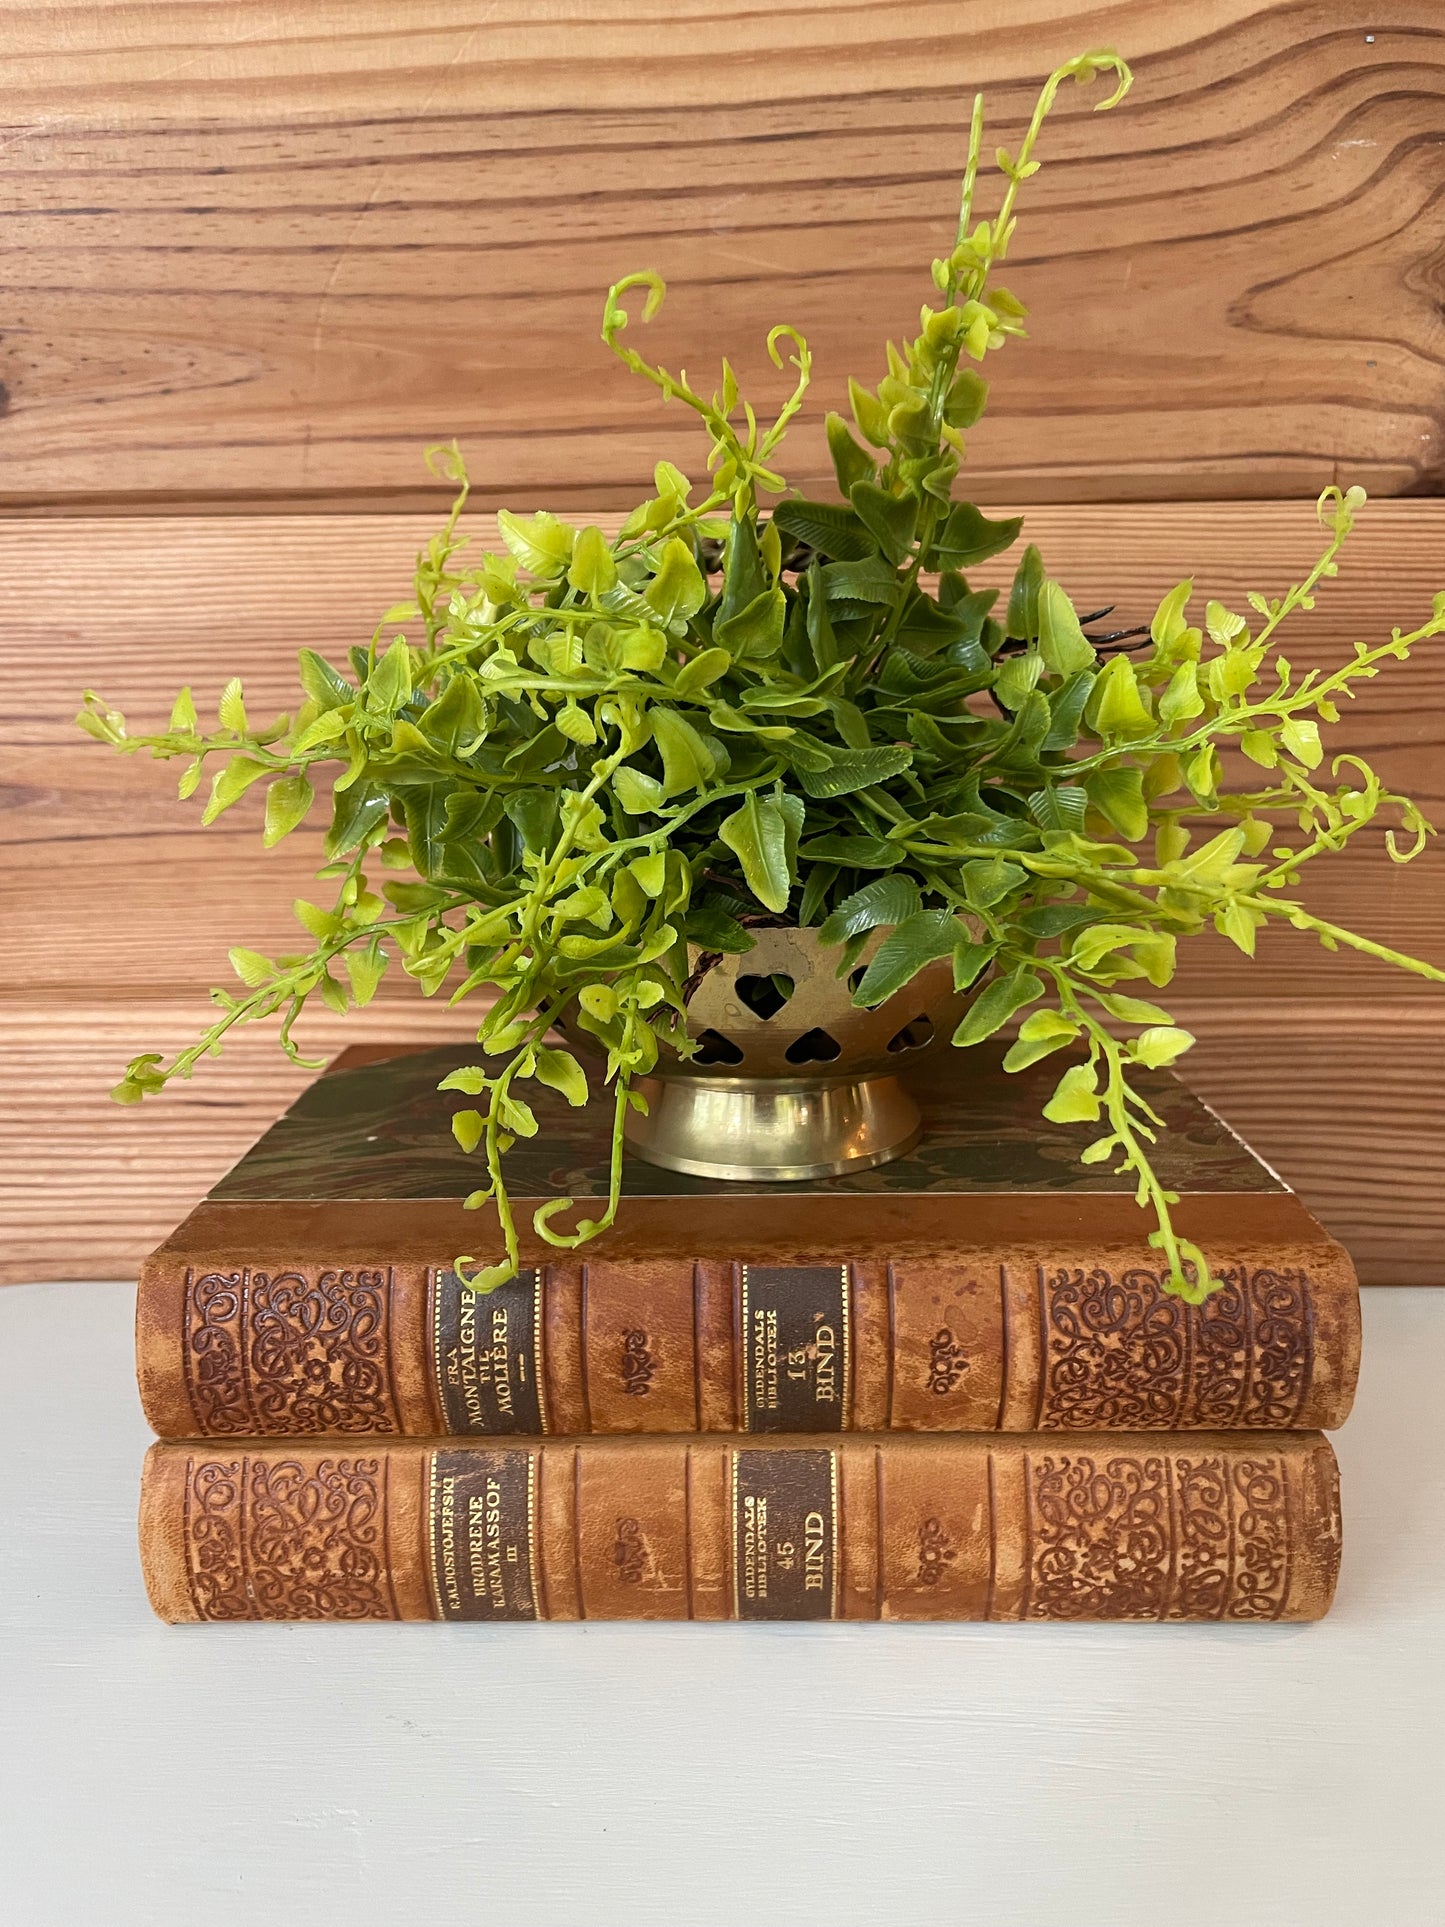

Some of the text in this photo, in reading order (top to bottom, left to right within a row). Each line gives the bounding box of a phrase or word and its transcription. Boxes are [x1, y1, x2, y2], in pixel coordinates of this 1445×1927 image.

[447, 1348, 459, 1385] FRA
[460, 1290, 484, 1427] MONTAIGNE
[479, 1350, 491, 1384] TIL
[490, 1308, 514, 1416] MOLIÈRE
[755, 1310, 765, 1408] GYLDENDALS
[767, 1309, 777, 1409] BIBLIOTEK
[787, 1350, 806, 1381] 13
[816, 1325, 835, 1402] BIND
[469, 1496, 486, 1597] BRØDRENE
[486, 1478, 506, 1608] KARAMASSOF
[506, 1545, 518, 1562] III
[744, 1496, 755, 1598] GYLDENDALS
[757, 1497, 767, 1598] BIBLIOTEK
[777, 1542, 794, 1570] 45
[805, 1512, 824, 1591] BIND
